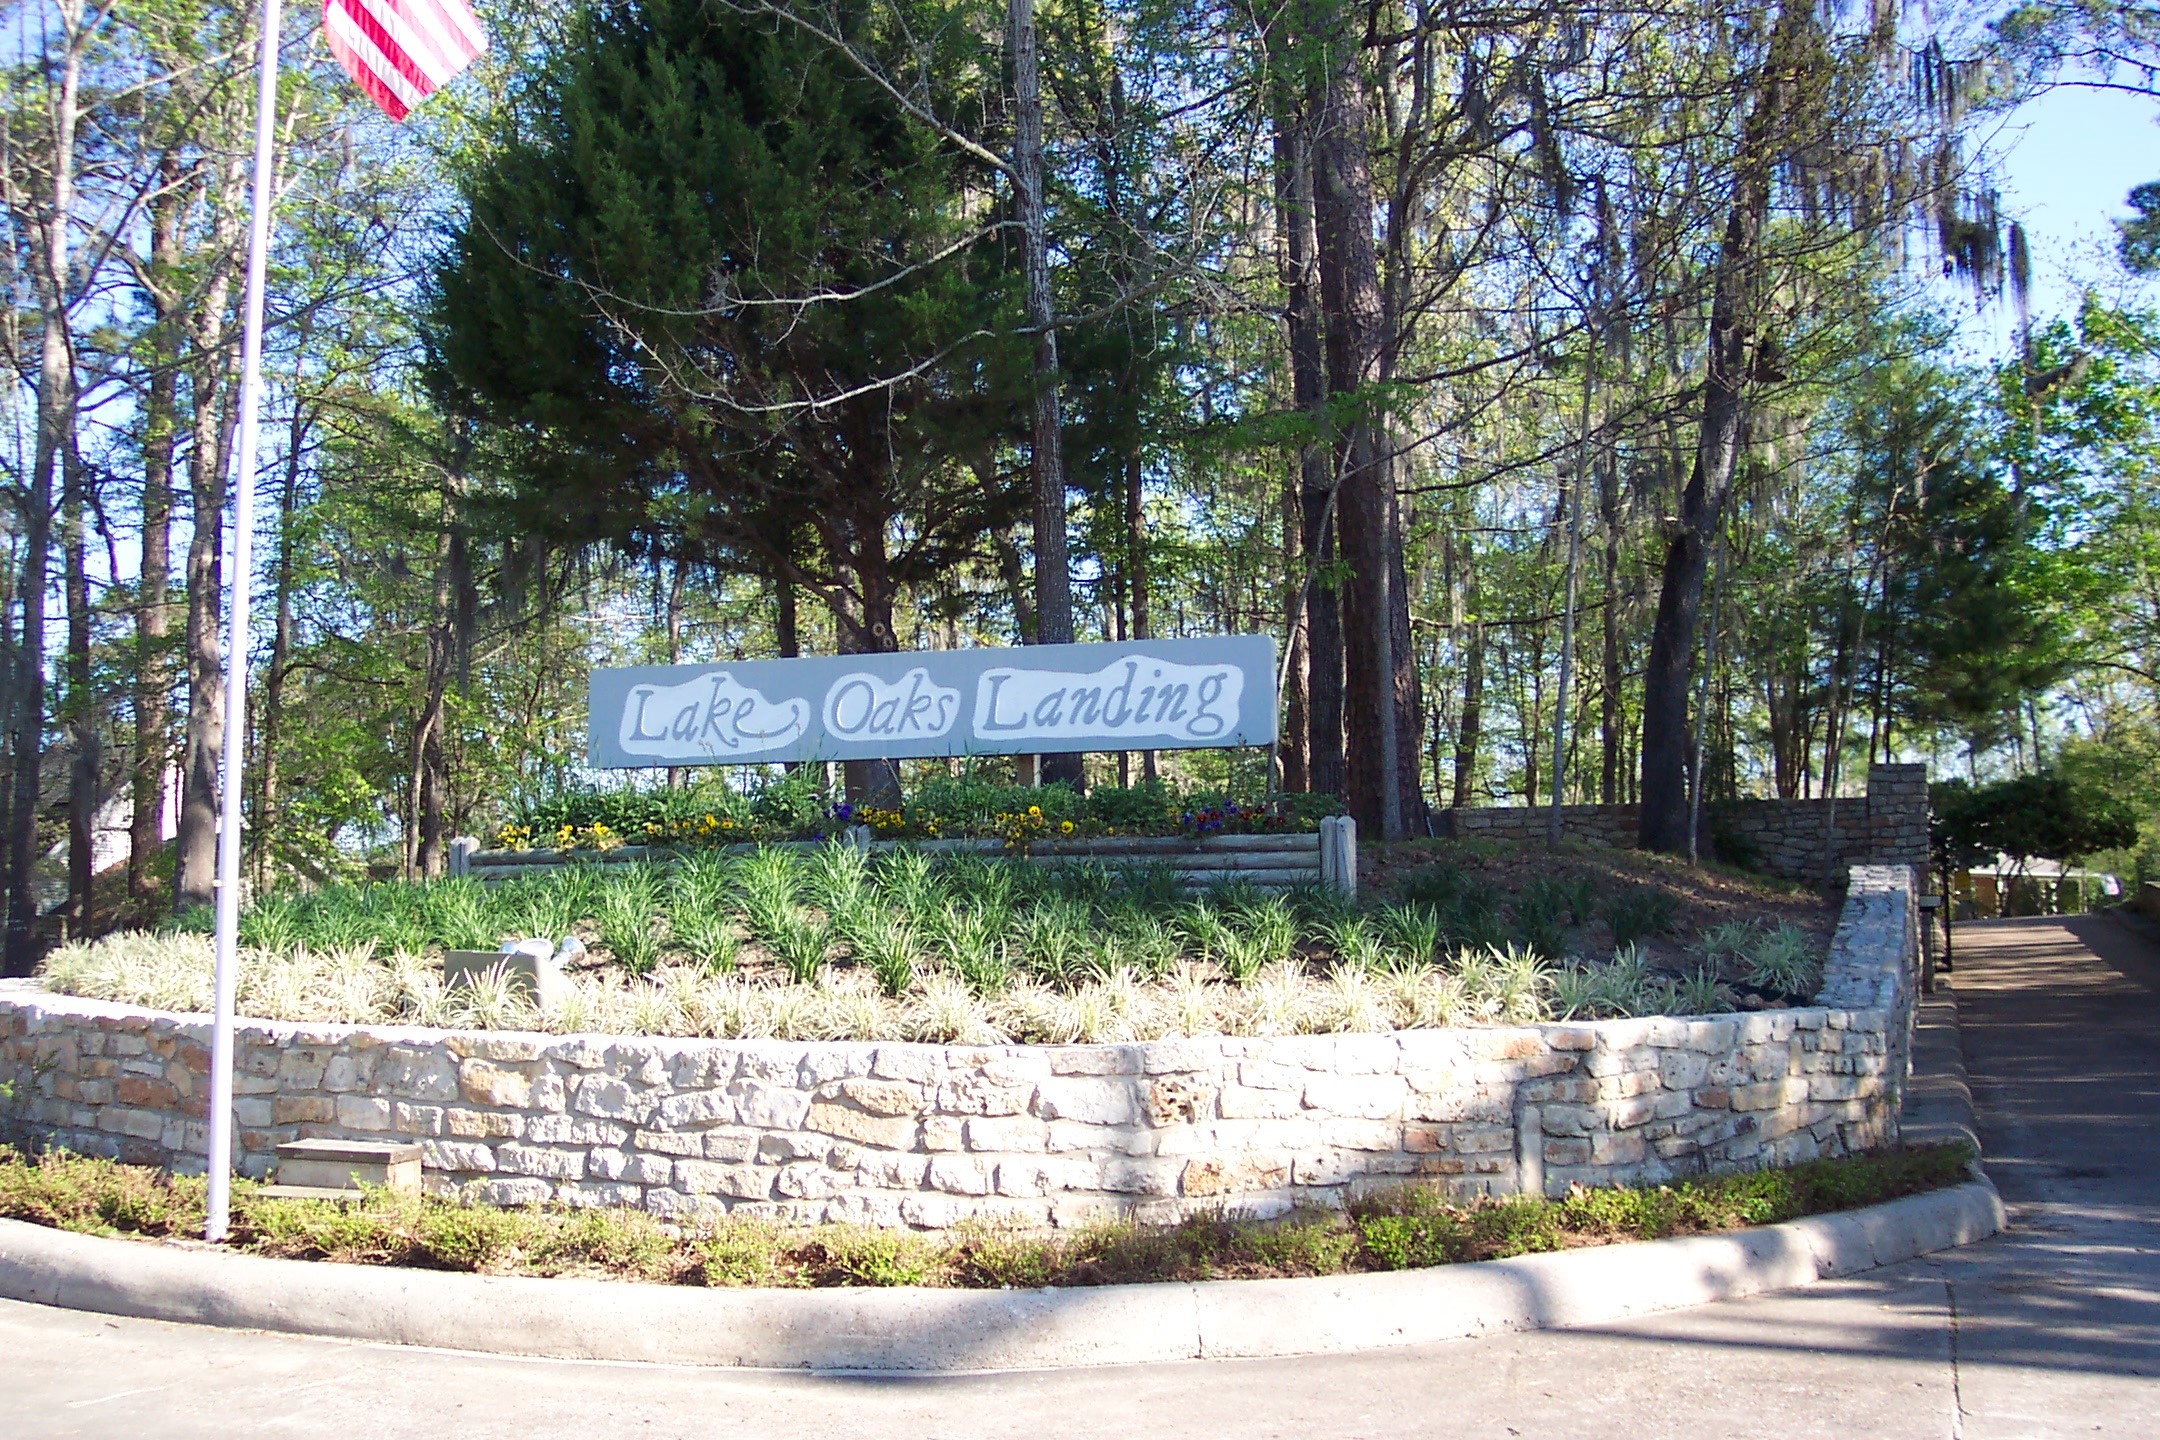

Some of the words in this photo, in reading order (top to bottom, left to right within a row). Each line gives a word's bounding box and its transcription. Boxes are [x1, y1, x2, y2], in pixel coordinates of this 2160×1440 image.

[629, 676, 799, 748] Lake
[831, 673, 954, 733] Oaks
[984, 660, 1228, 736] Landing
